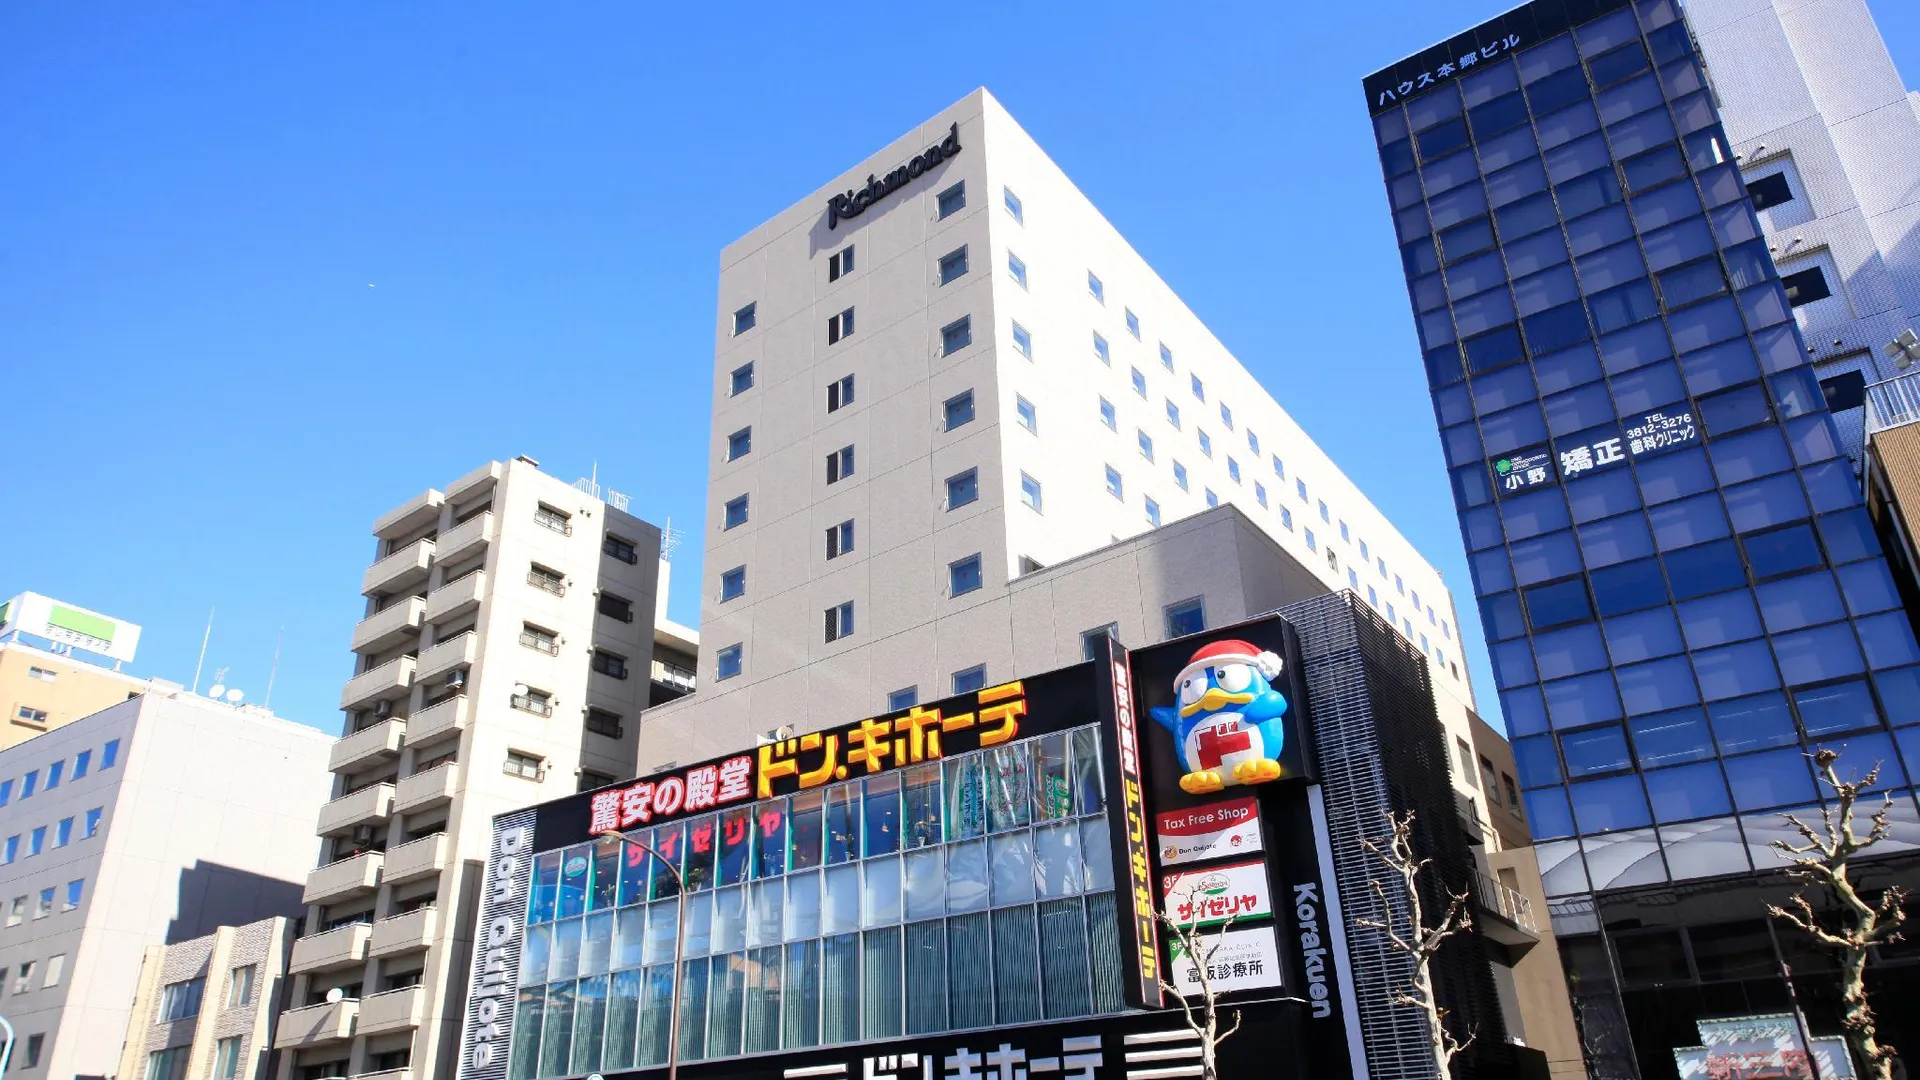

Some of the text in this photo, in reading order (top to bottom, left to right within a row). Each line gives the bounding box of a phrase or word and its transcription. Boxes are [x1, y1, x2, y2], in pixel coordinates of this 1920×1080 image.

[1379, 33, 1520, 106] ハウス本郷ビル
[827, 121, 963, 231] Richmond
[1626, 413, 1692, 439] 3812-3276
[1645, 413, 1667, 424] TEL
[1506, 424, 1695, 490] 小野 矯正 歯科クリニック
[588, 755, 753, 835] 驚安の殿堂
[1164, 807, 1249, 830] Tax Free Shop
[493, 826, 526, 905] Don
[628, 811, 781, 868] サイゼリヤ
[1163, 875, 1177, 889] 3F
[1177, 895, 1257, 920] サイゼリヤ
[1293, 882, 1331, 1019] Korakuen
